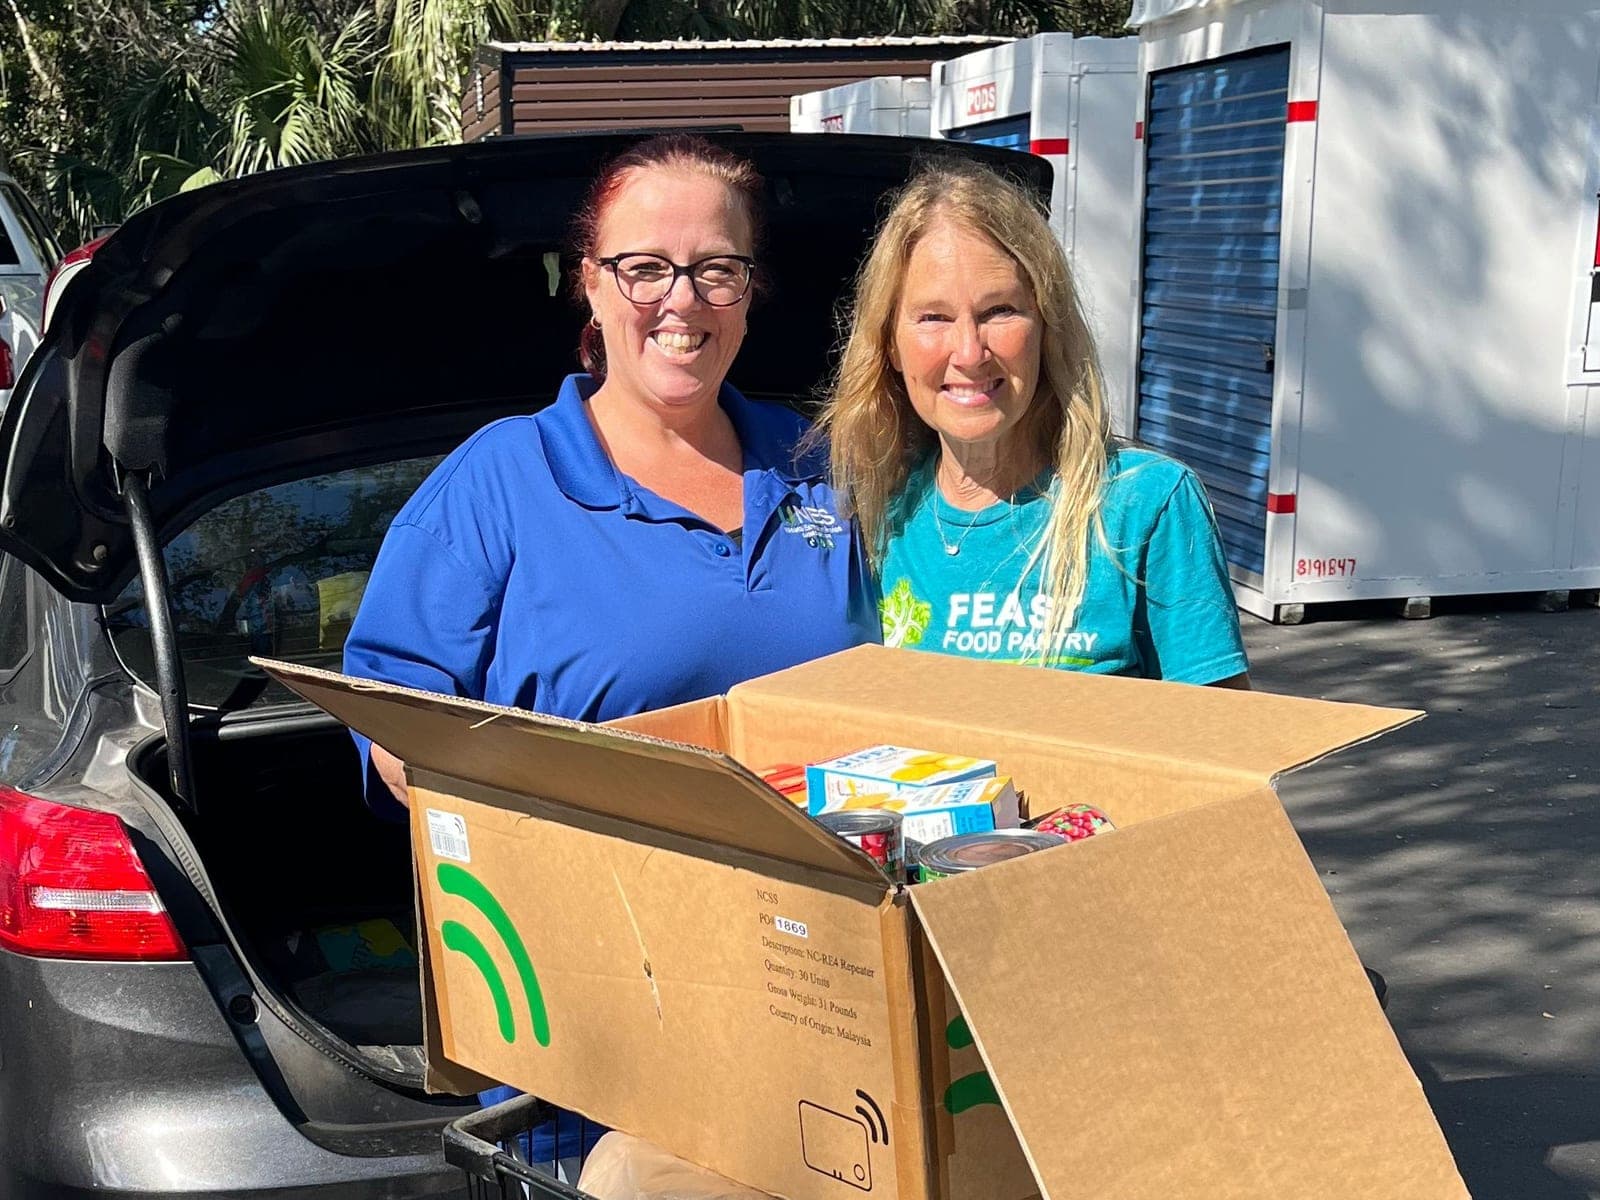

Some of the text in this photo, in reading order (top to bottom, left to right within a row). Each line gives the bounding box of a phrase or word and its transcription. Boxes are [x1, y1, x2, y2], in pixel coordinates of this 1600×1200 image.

[967, 85, 996, 113] PODS
[942, 631, 1001, 653] FOOD
[756, 889, 779, 904] NCSS
[777, 918, 806, 936] 1869
[762, 936, 805, 959] Description:
[841, 959, 875, 978] Repeater
[799, 970, 809, 981] 30
[810, 973, 830, 988] Units
[767, 982, 857, 1019] Gross Weight: 31 Pounds
[769, 1004, 872, 1047] Country of Origin: Malaysia
